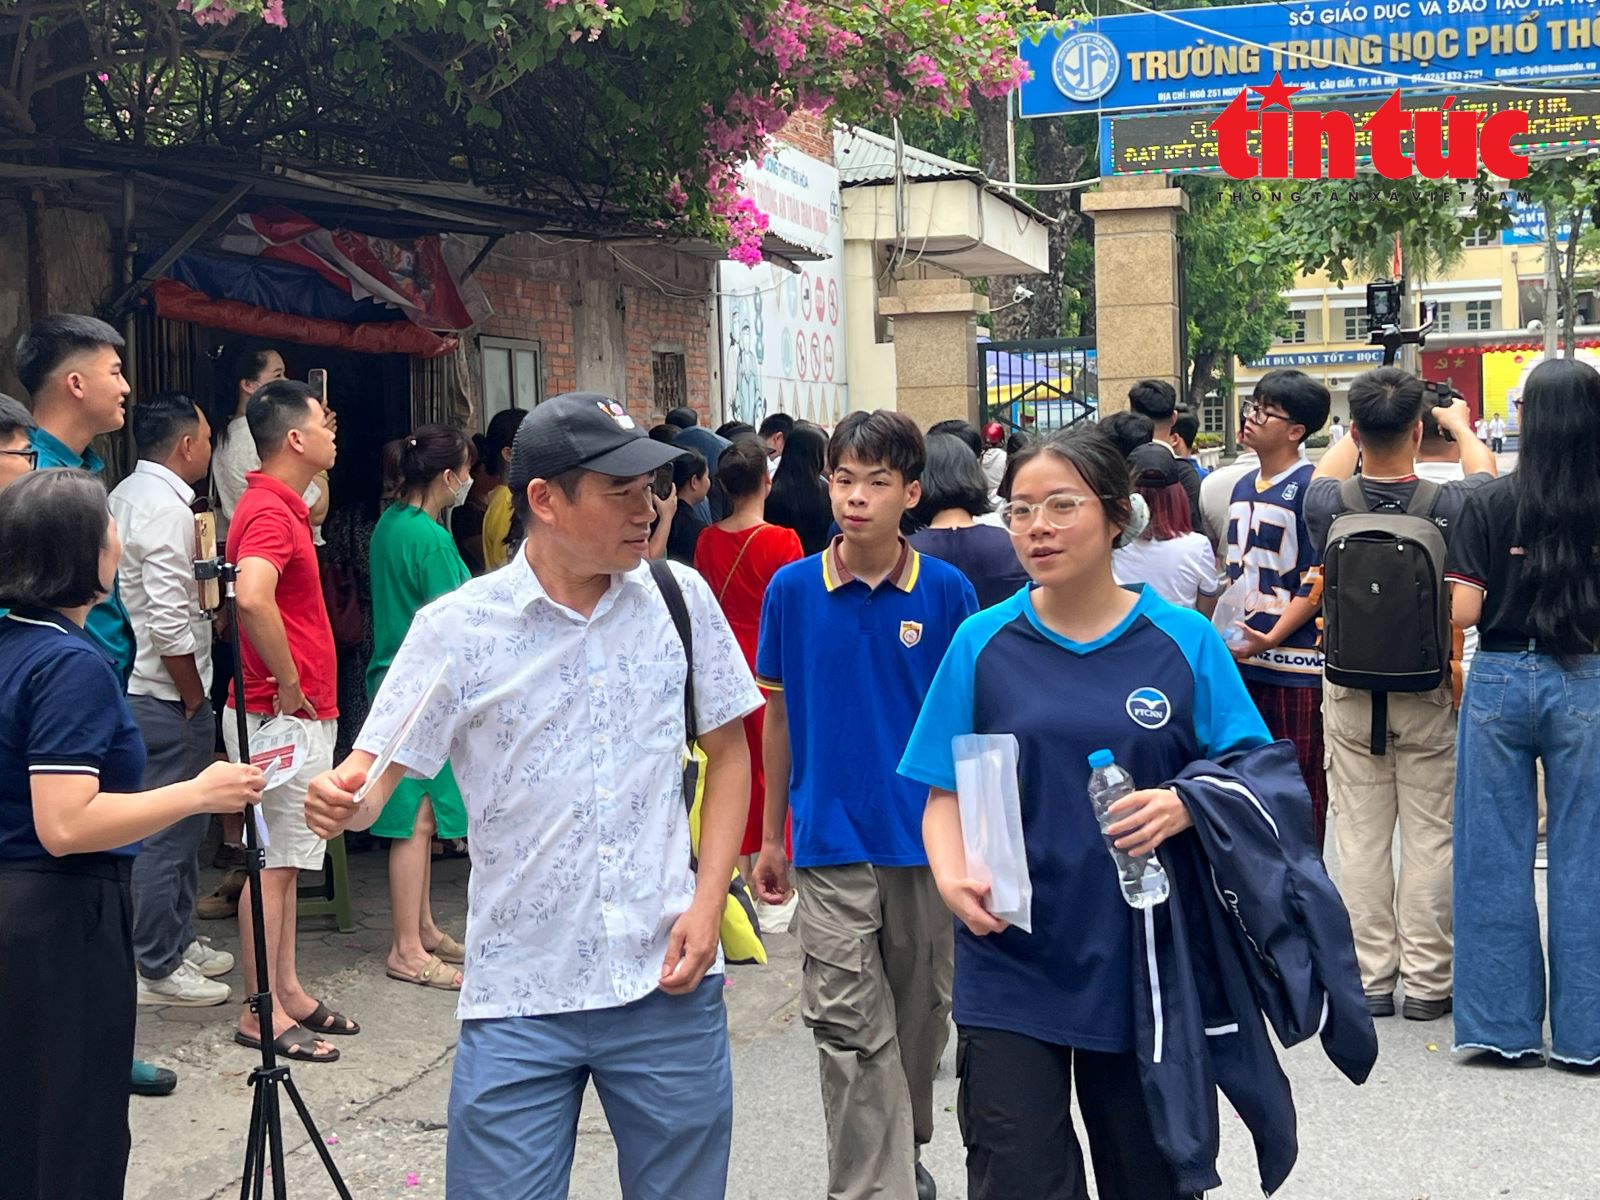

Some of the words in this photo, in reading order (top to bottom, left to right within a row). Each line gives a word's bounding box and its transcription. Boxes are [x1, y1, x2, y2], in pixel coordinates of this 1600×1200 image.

[1289, 5, 1315, 26] SỞ
[1320, 1, 1368, 24] GIÁO
[1374, 3, 1411, 24] DỤC
[1127, 40, 1260, 82] TRƯỜNG
[1272, 34, 1383, 72] TRUNG
[1389, 27, 1459, 67] HỌC
[1466, 10, 1540, 57] PHỐ
[1207, 89, 1221, 98] 251
[1274, 356, 1295, 366] ĐUA
[1298, 355, 1319, 367] DẠY
[1323, 351, 1345, 363] TỐT
[1357, 351, 1379, 363] HỌC
